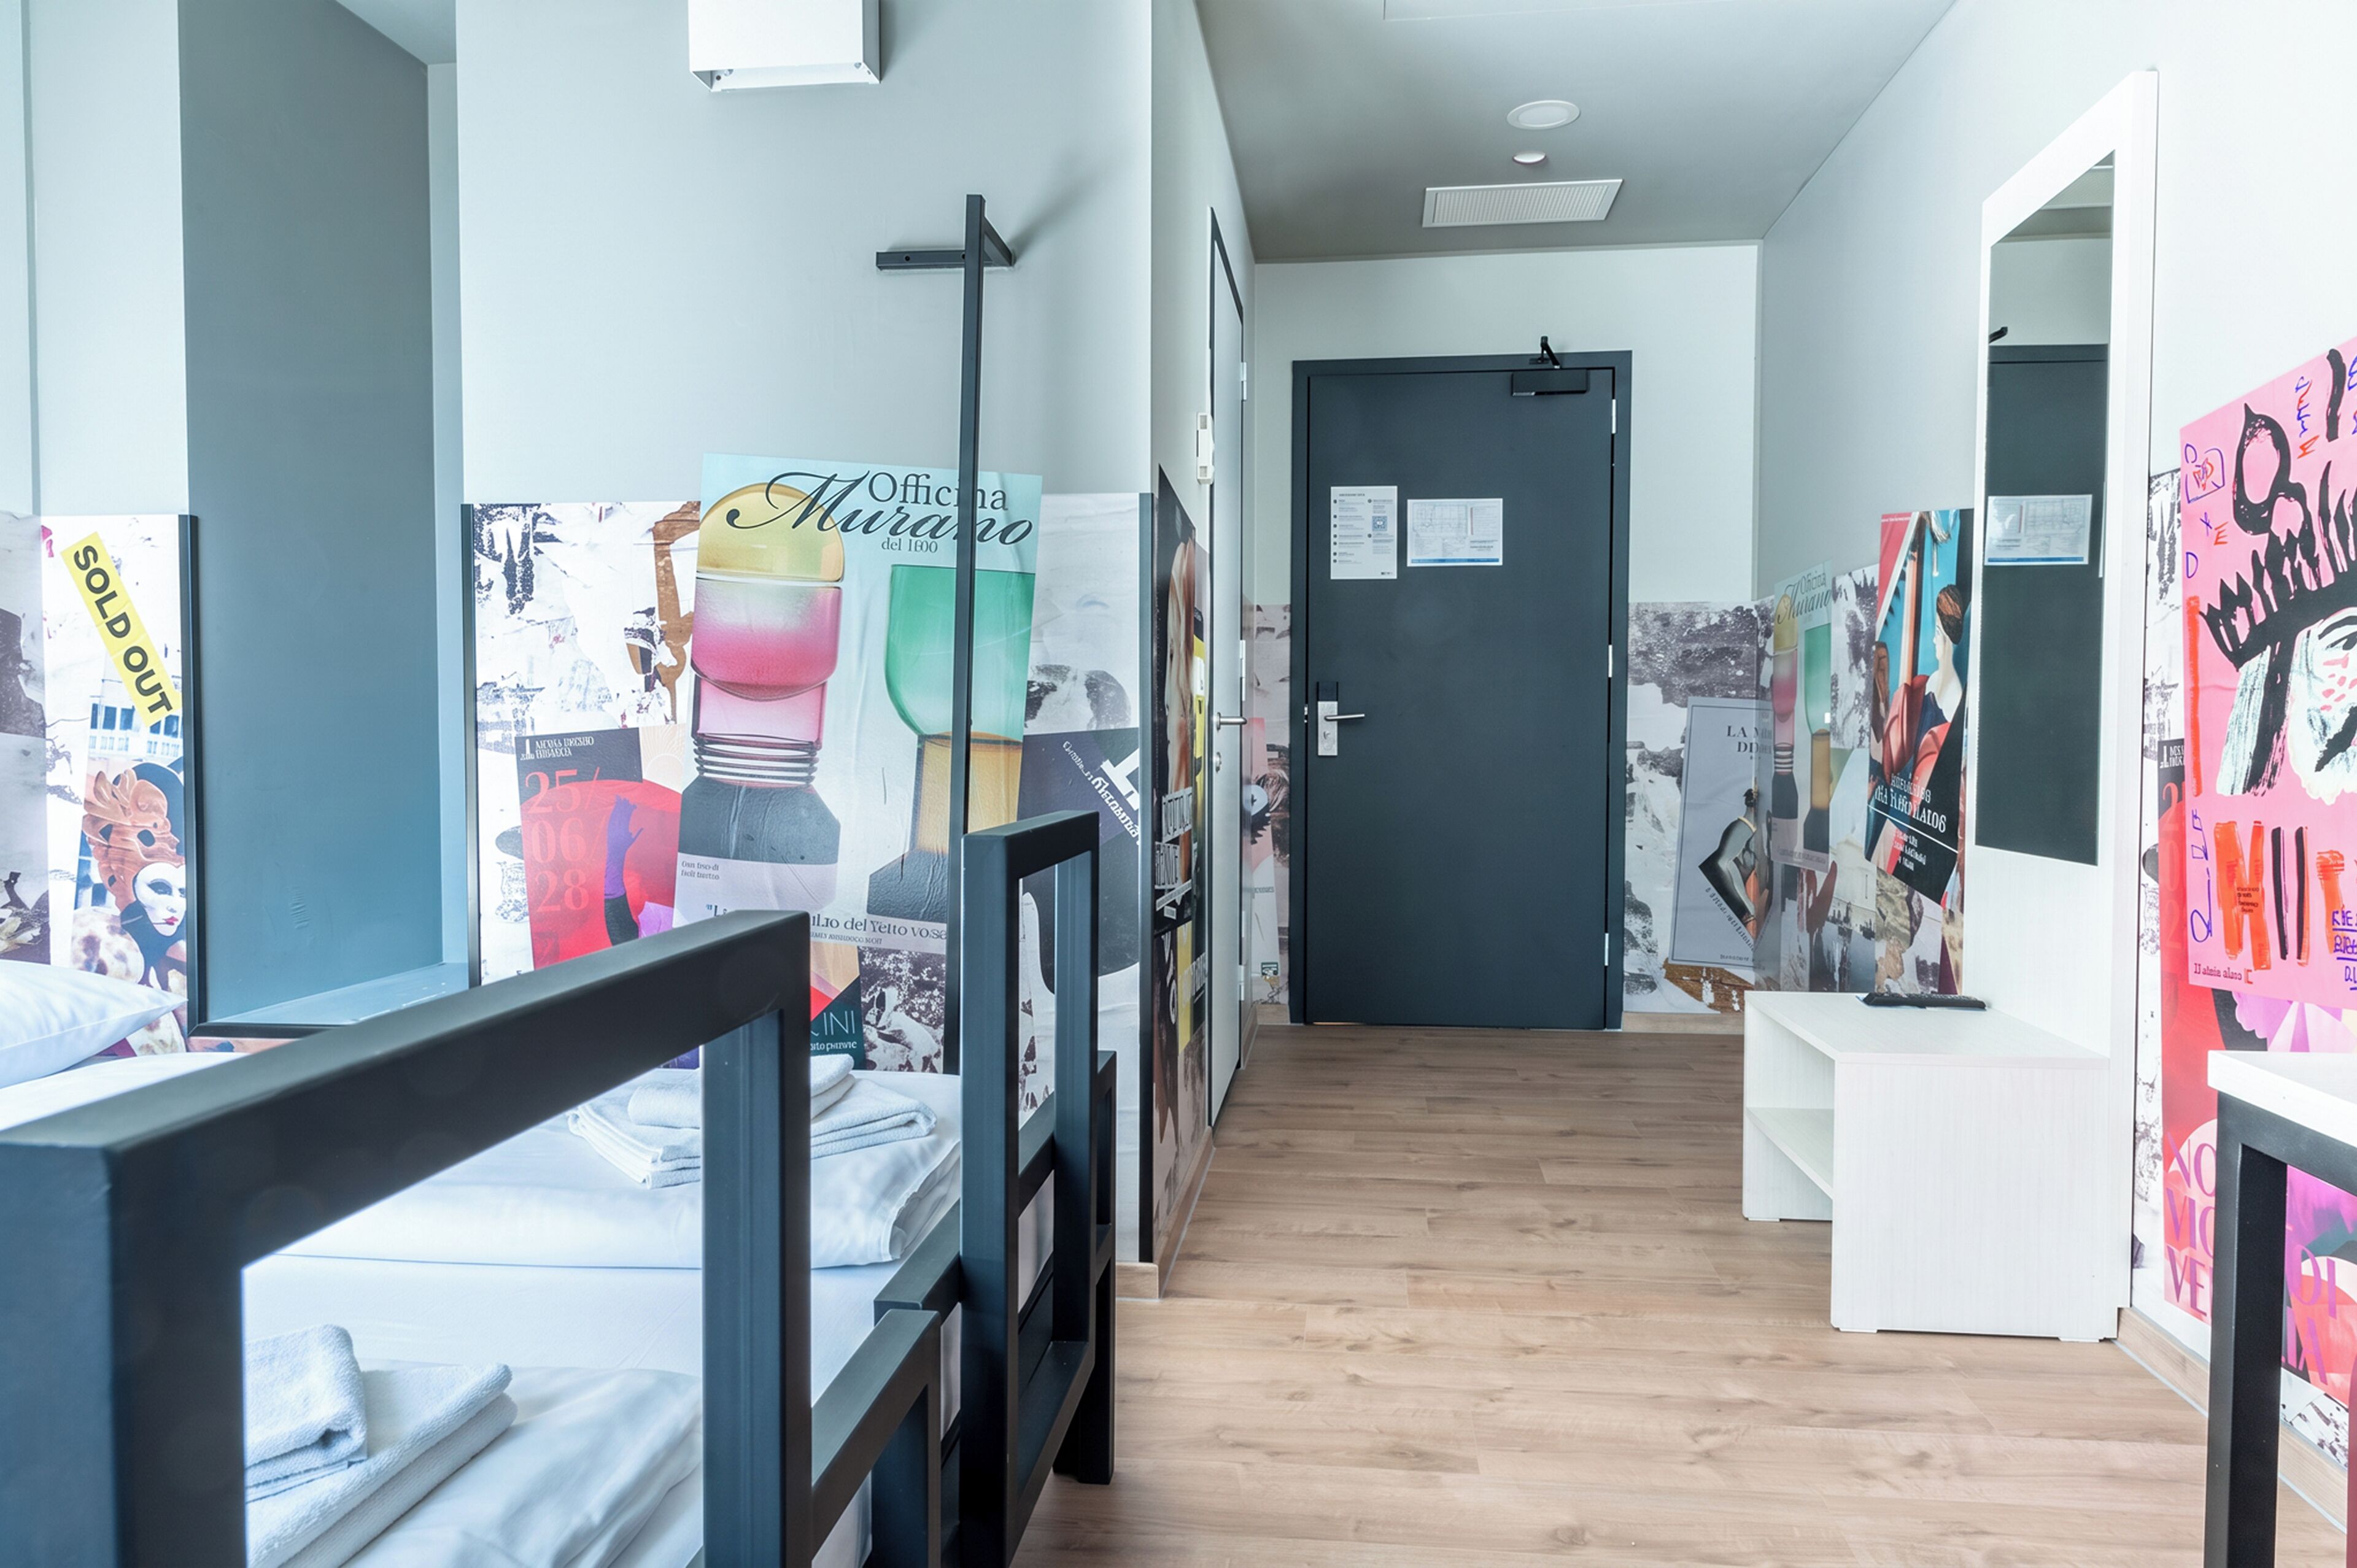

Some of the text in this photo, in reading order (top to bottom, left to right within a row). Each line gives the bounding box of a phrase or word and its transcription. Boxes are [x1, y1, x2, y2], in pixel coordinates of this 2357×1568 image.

[726, 470, 1033, 545] Murano
[881, 537, 902, 550] del
[74, 545, 173, 713] SOLD OUT
[1727, 725, 1747, 738] LA
[535, 868, 589, 913] 28
